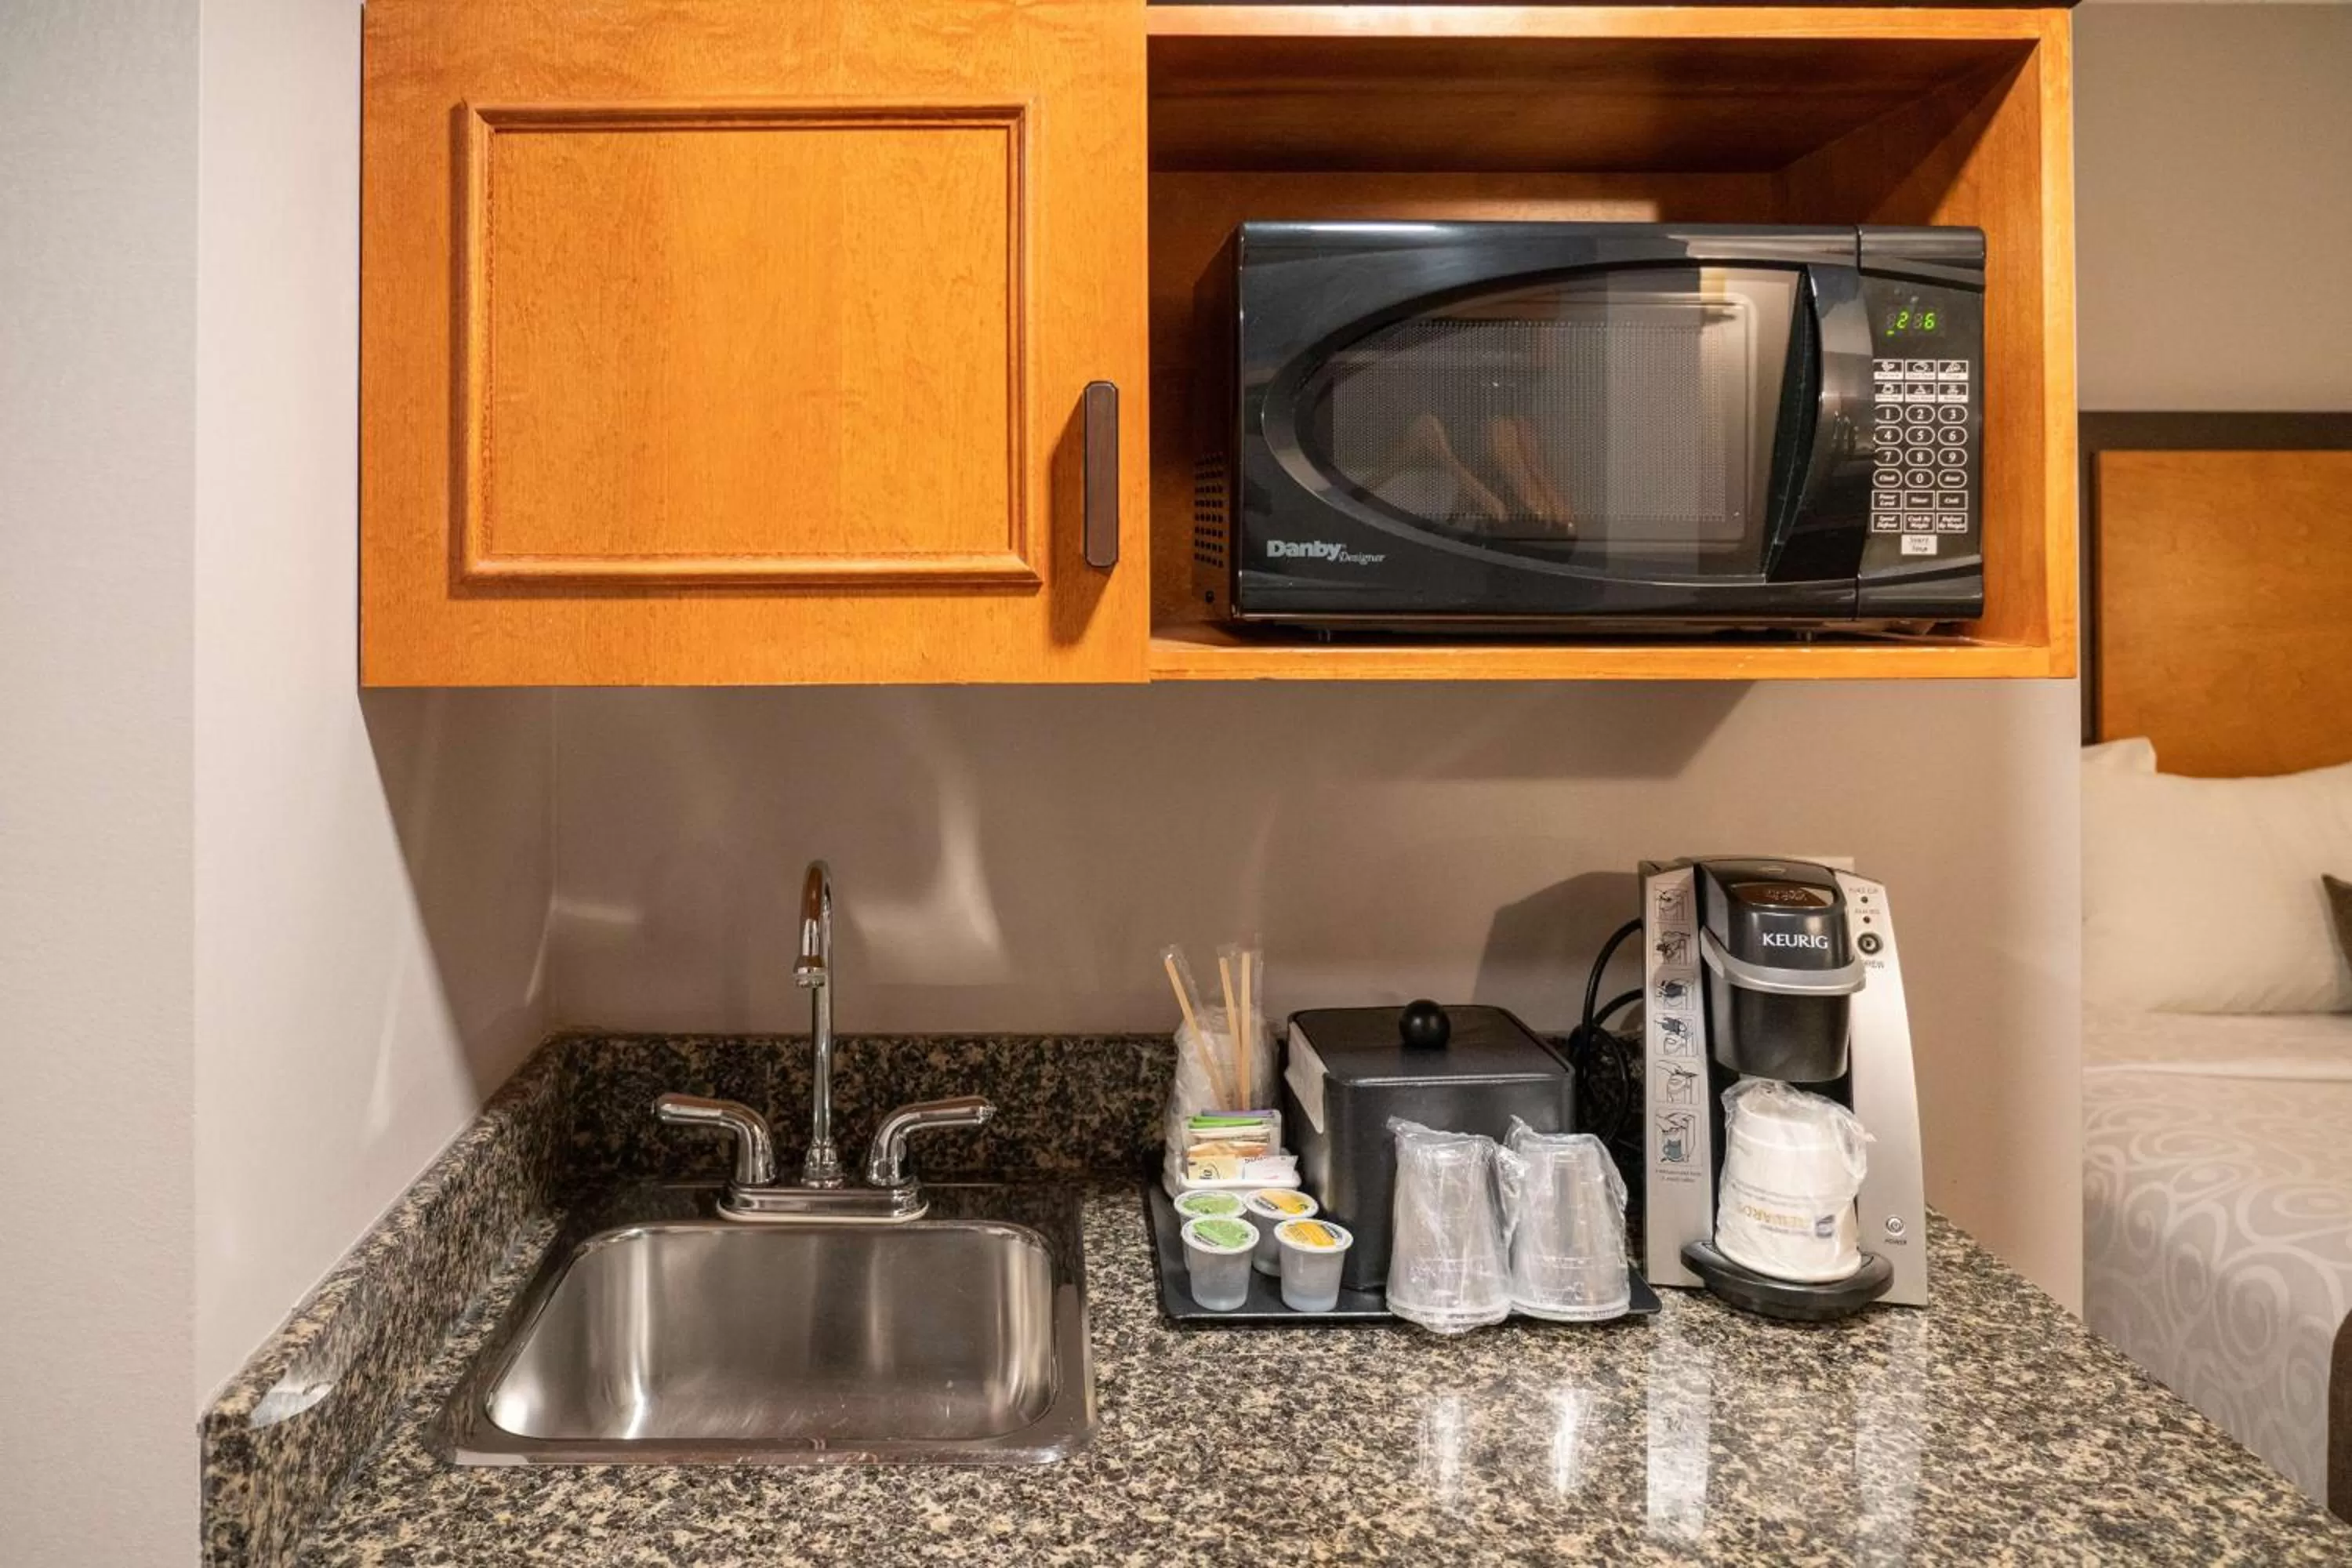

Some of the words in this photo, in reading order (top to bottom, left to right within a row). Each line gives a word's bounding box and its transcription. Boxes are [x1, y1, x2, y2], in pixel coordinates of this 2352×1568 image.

[1885, 408, 1891, 419] 1
[1917, 408, 1924, 419] 2
[1950, 409, 1956, 419] 3
[1884, 430, 1892, 441] 4
[1917, 430, 1924, 441] 5
[1949, 431, 1956, 441] 6
[1884, 452, 1892, 463] 7
[1917, 452, 1923, 462] 8
[1948, 452, 1956, 463] 9
[1916, 473, 1924, 483] 0
[1266, 539, 1341, 561] Danby
[1339, 551, 1386, 565] Designer
[1762, 932, 1829, 949] KEURIG
